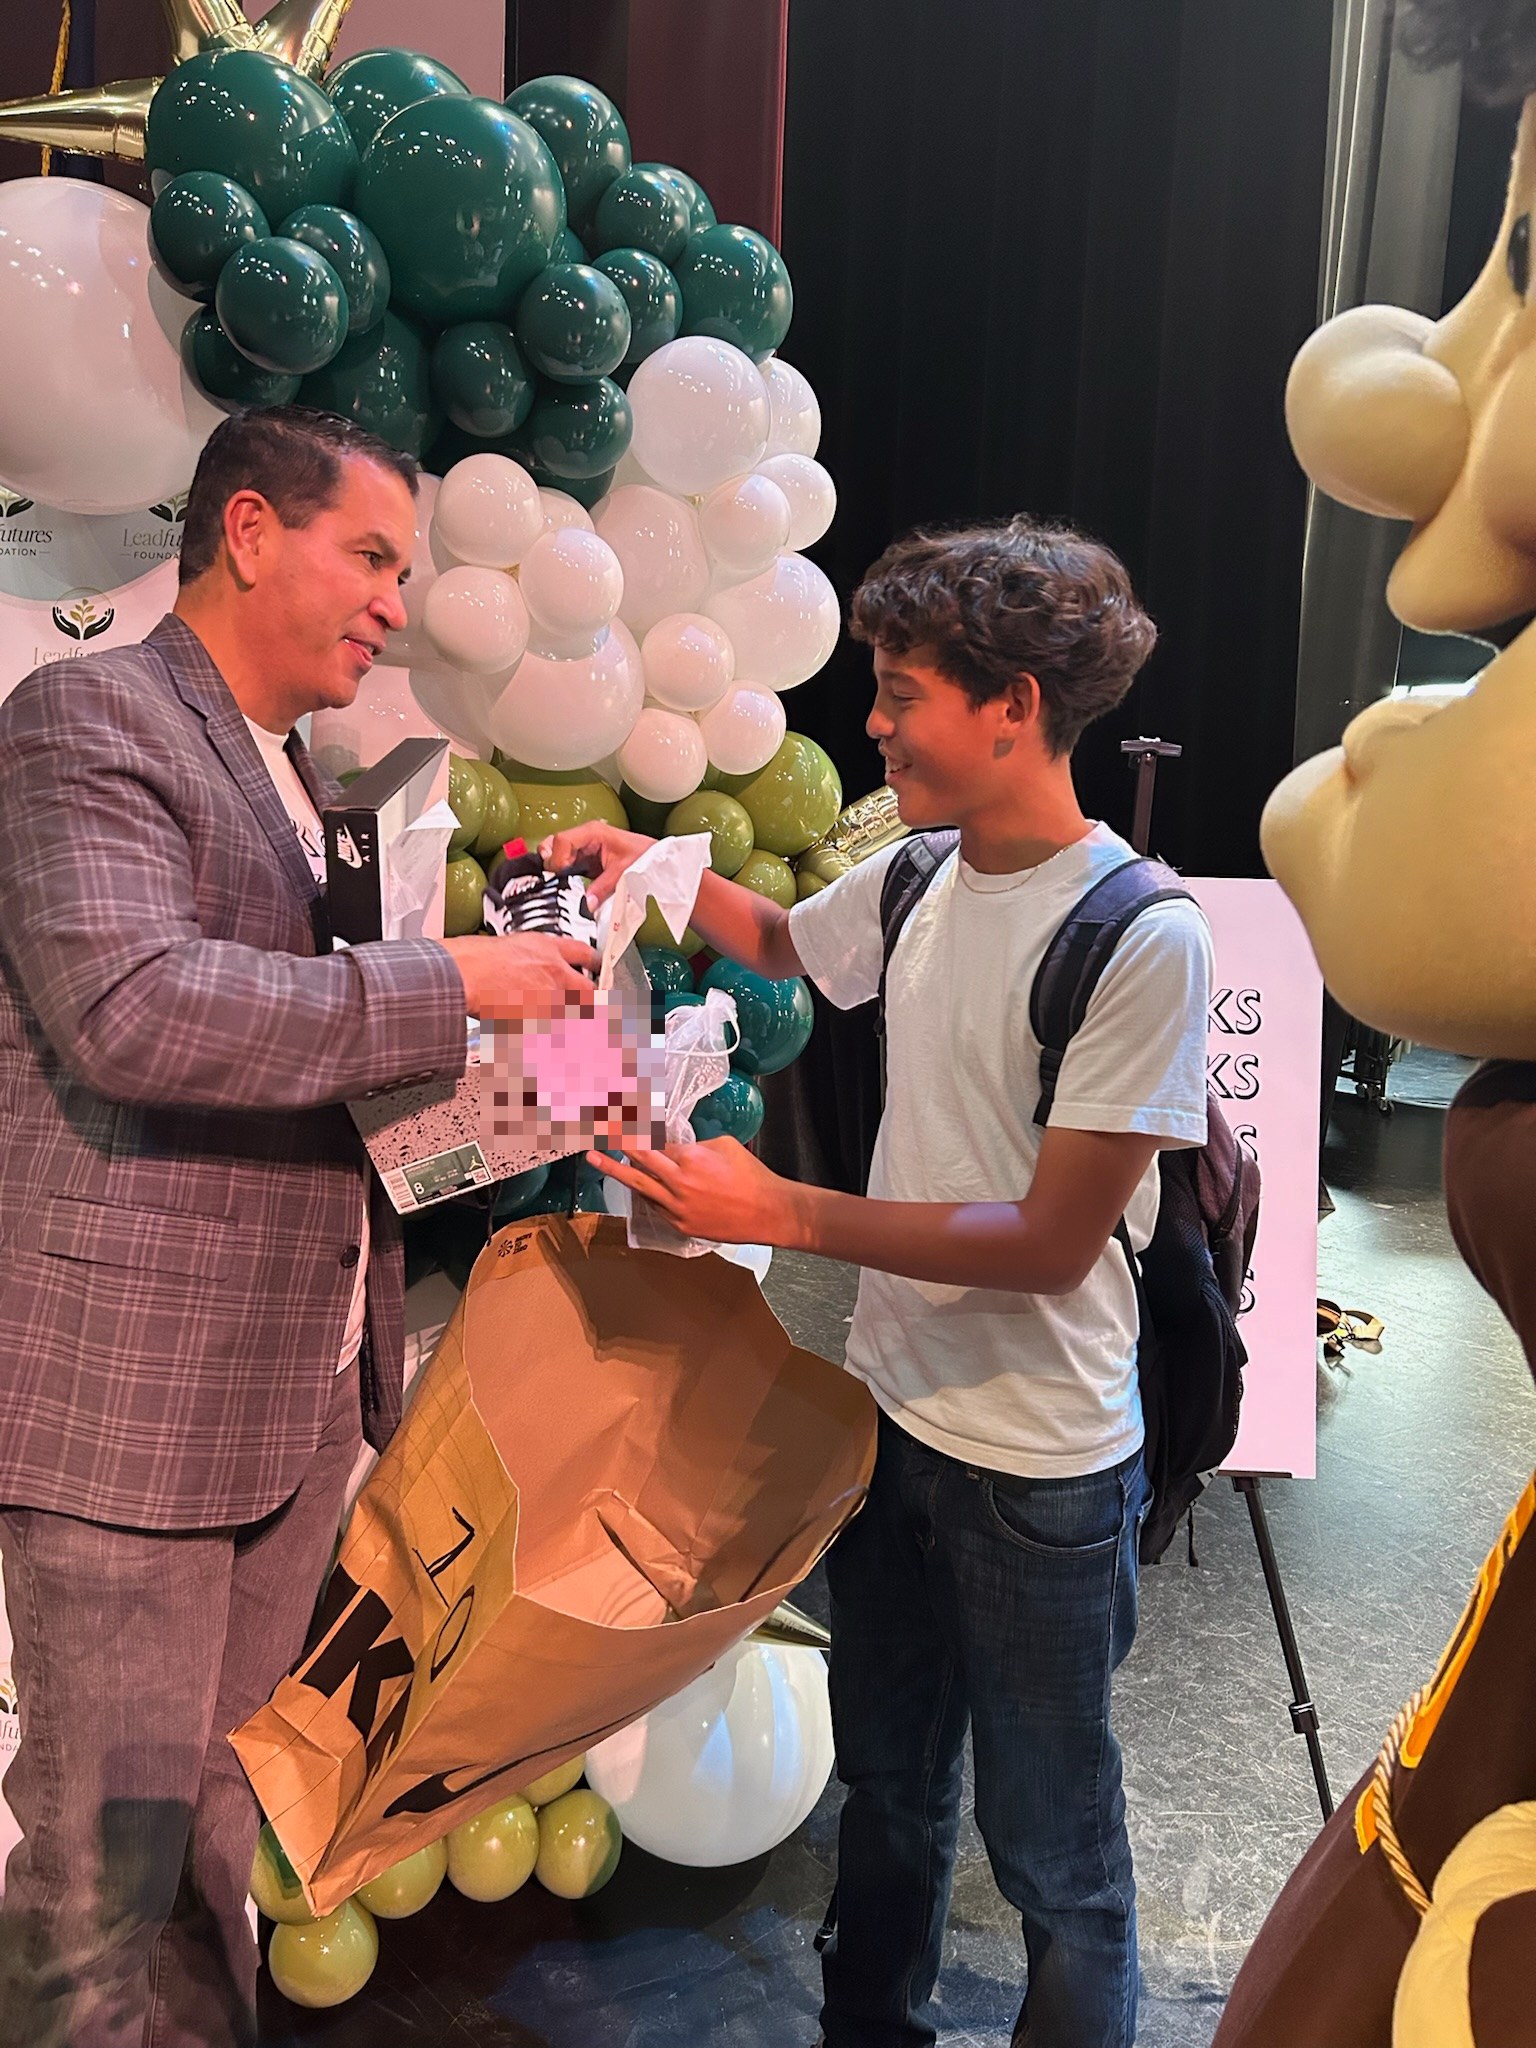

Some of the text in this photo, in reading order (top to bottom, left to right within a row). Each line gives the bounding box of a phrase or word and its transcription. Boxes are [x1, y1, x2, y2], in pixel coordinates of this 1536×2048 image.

[0, 523, 53, 544] utures
[361, 833, 371, 863] AIR
[413, 1182, 425, 1195] 8
